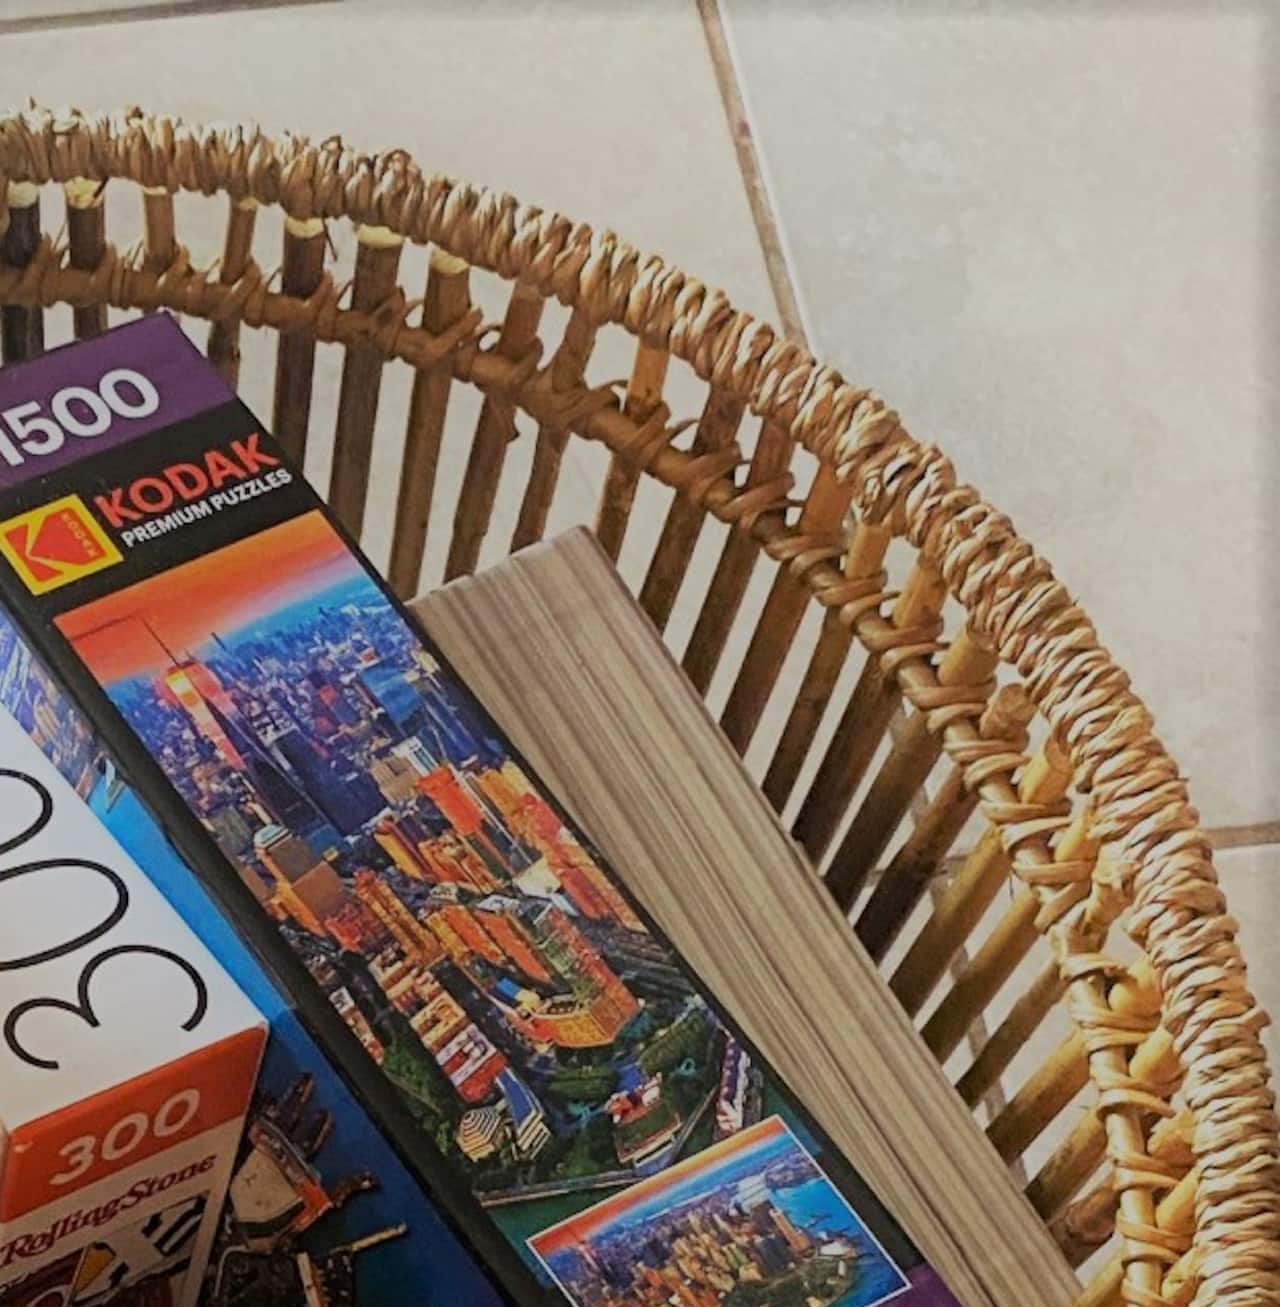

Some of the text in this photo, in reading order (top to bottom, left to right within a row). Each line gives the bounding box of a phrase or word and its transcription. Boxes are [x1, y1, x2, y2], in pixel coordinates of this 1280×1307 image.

[94, 432, 281, 528] KODAK
[120, 467, 294, 549] PREMIUM PUZZLES
[48, 1087, 202, 1189] 300
